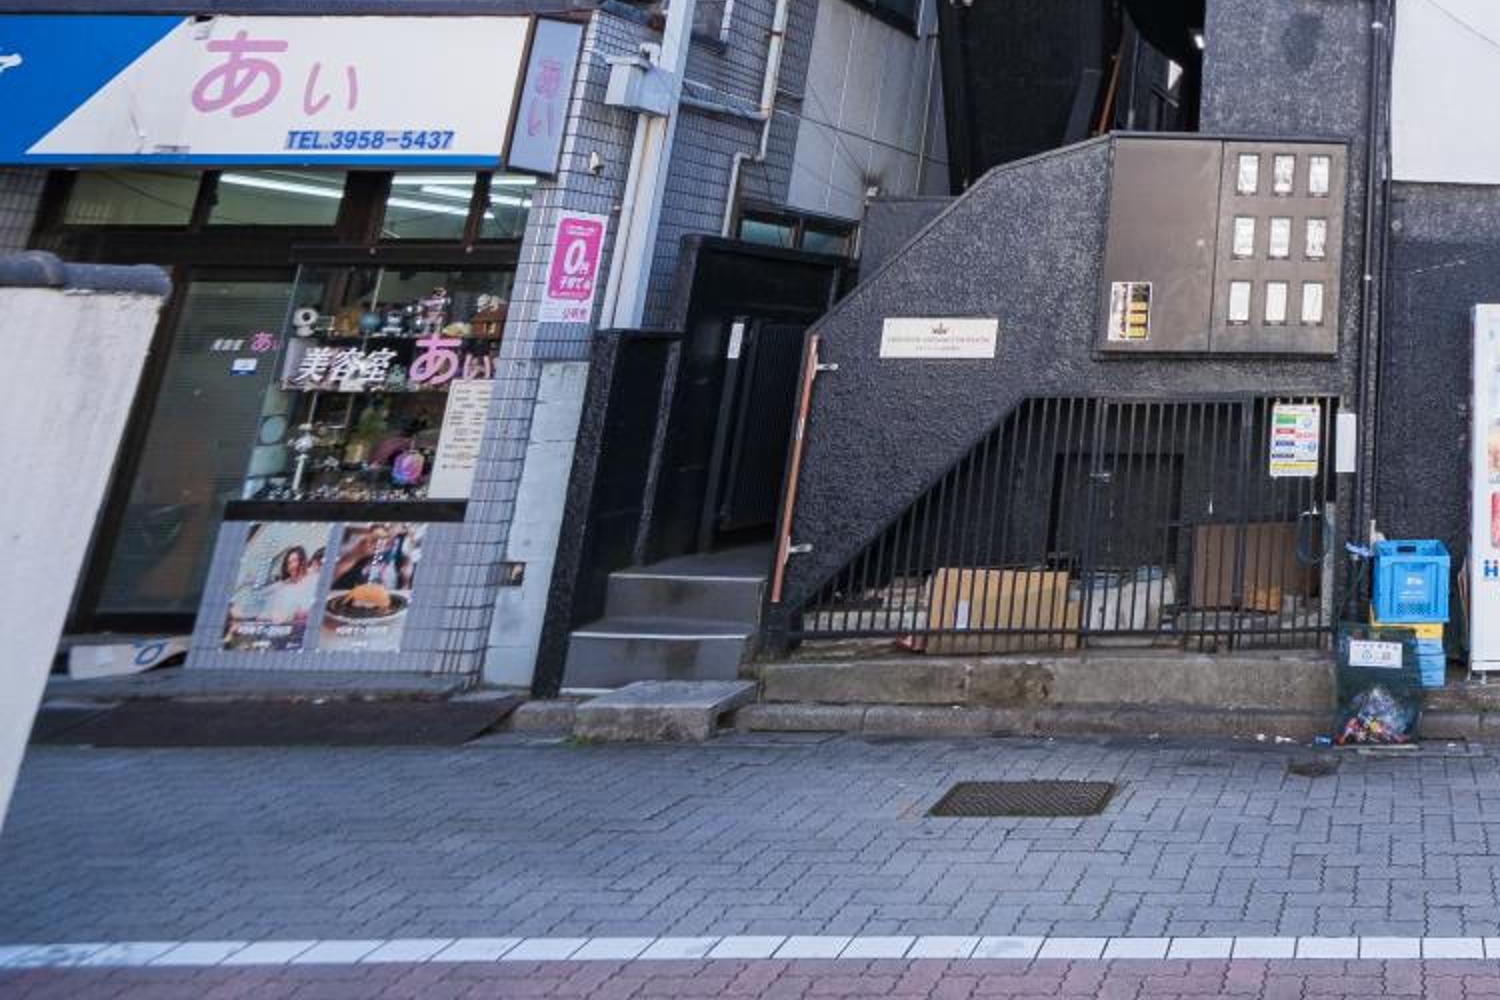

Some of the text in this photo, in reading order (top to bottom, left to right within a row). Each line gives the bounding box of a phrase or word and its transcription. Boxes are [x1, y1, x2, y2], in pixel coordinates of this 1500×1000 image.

[191, 31, 359, 118] あい
[285, 130, 455, 151] TEL.3958-5437
[296, 333, 492, 386] 美容室 あい
